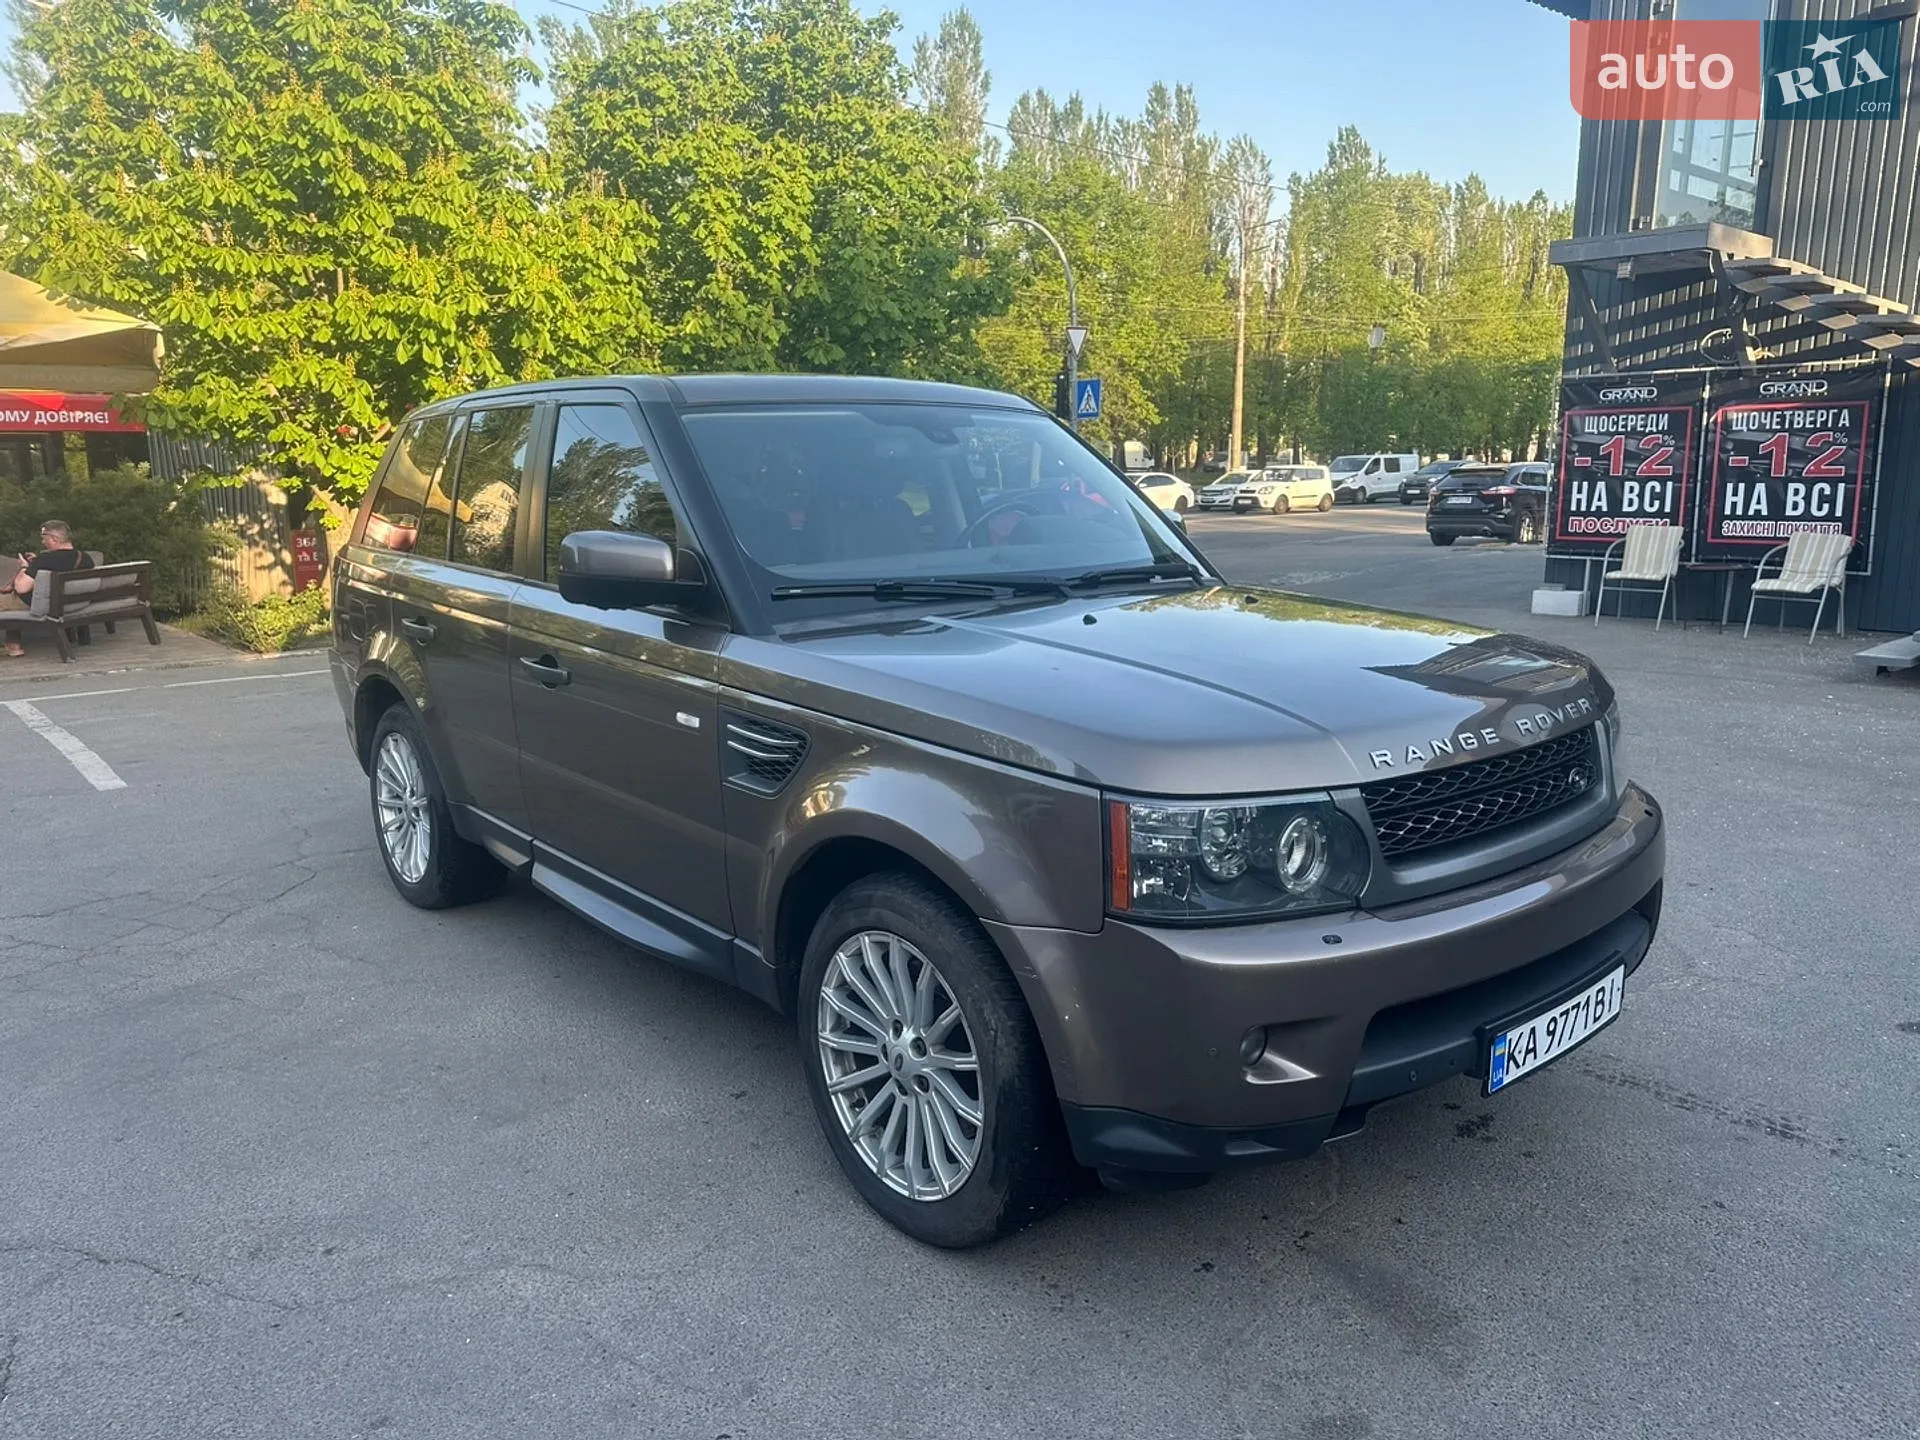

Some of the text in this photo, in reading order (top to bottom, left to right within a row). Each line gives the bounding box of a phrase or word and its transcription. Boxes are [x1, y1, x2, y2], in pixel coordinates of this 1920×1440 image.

[1600, 386, 1658, 400] GRAND
[1760, 379, 1828, 395] GRAND
[0, 411, 109, 425] МУ ДОВІРЯЄ!
[1584, 413, 1669, 434] ЩОСЕРЕДИ
[1732, 408, 1850, 432] ЩОЧЕТВЕРГА
[1570, 481, 1673, 513] НА ВСІ
[1724, 482, 1846, 517] НА ВСІ
[1722, 520, 1776, 537] ЗАХИСНІ
[1369, 697, 1593, 769] RANGE ROVER
